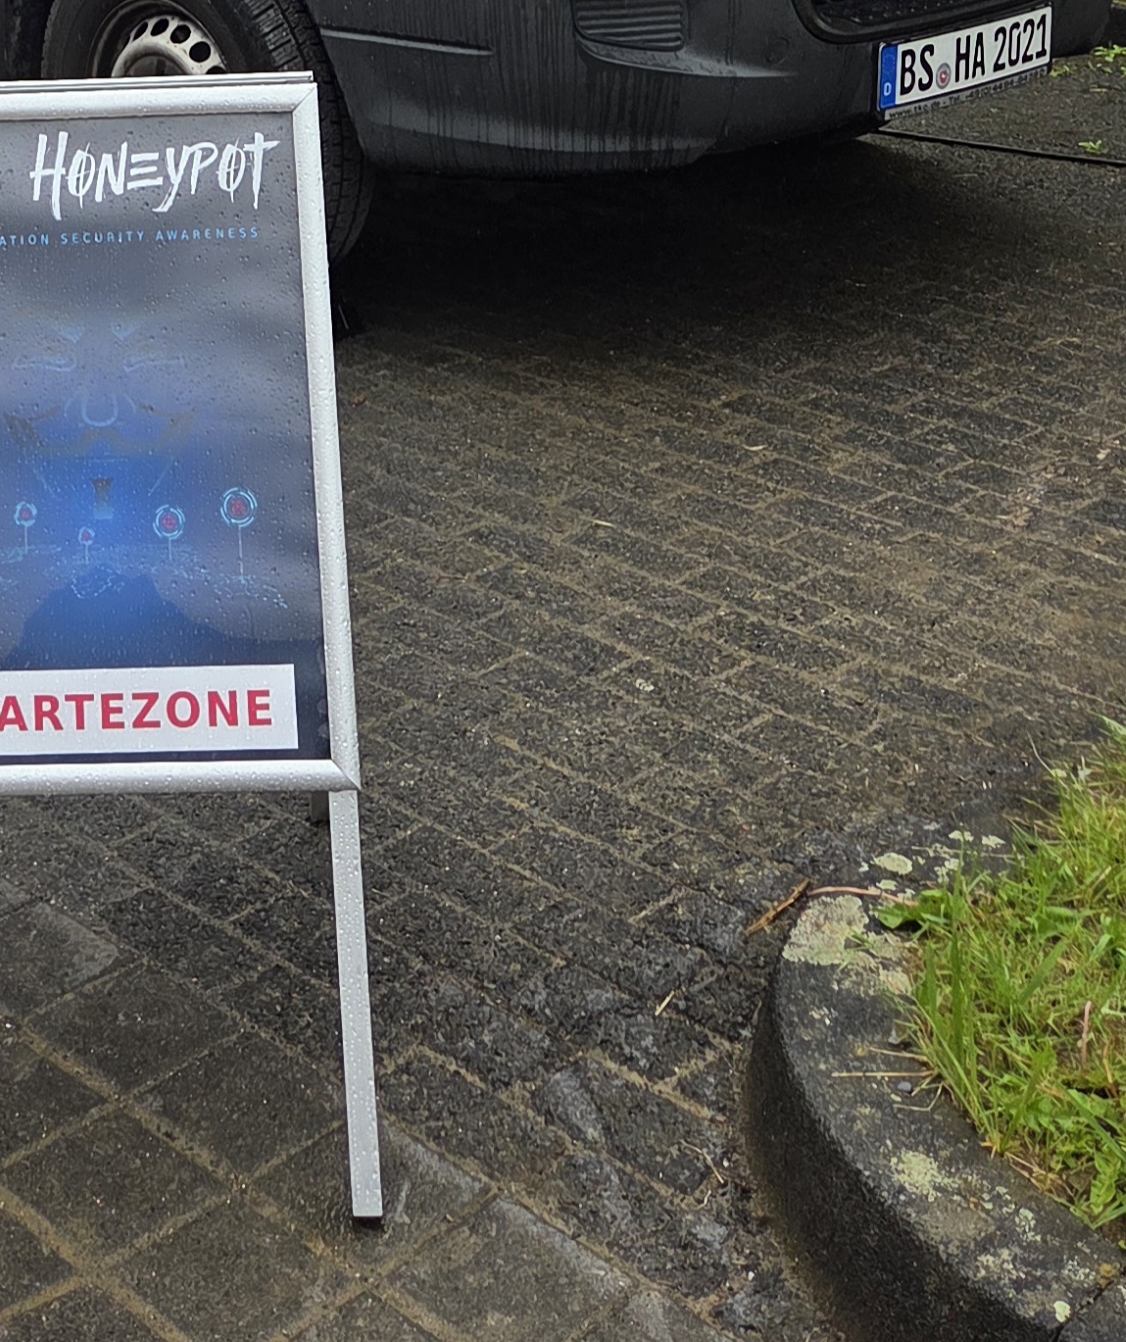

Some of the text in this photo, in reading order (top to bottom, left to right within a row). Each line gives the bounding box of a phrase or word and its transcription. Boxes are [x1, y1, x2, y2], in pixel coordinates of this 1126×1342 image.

[883, 82, 892, 96] D
[900, 44, 935, 95] BS
[955, 32, 986, 83] HA
[992, 14, 1047, 72] 2021
[60, 229, 145, 245] SECURITY
[155, 226, 259, 241] AWARENESS
